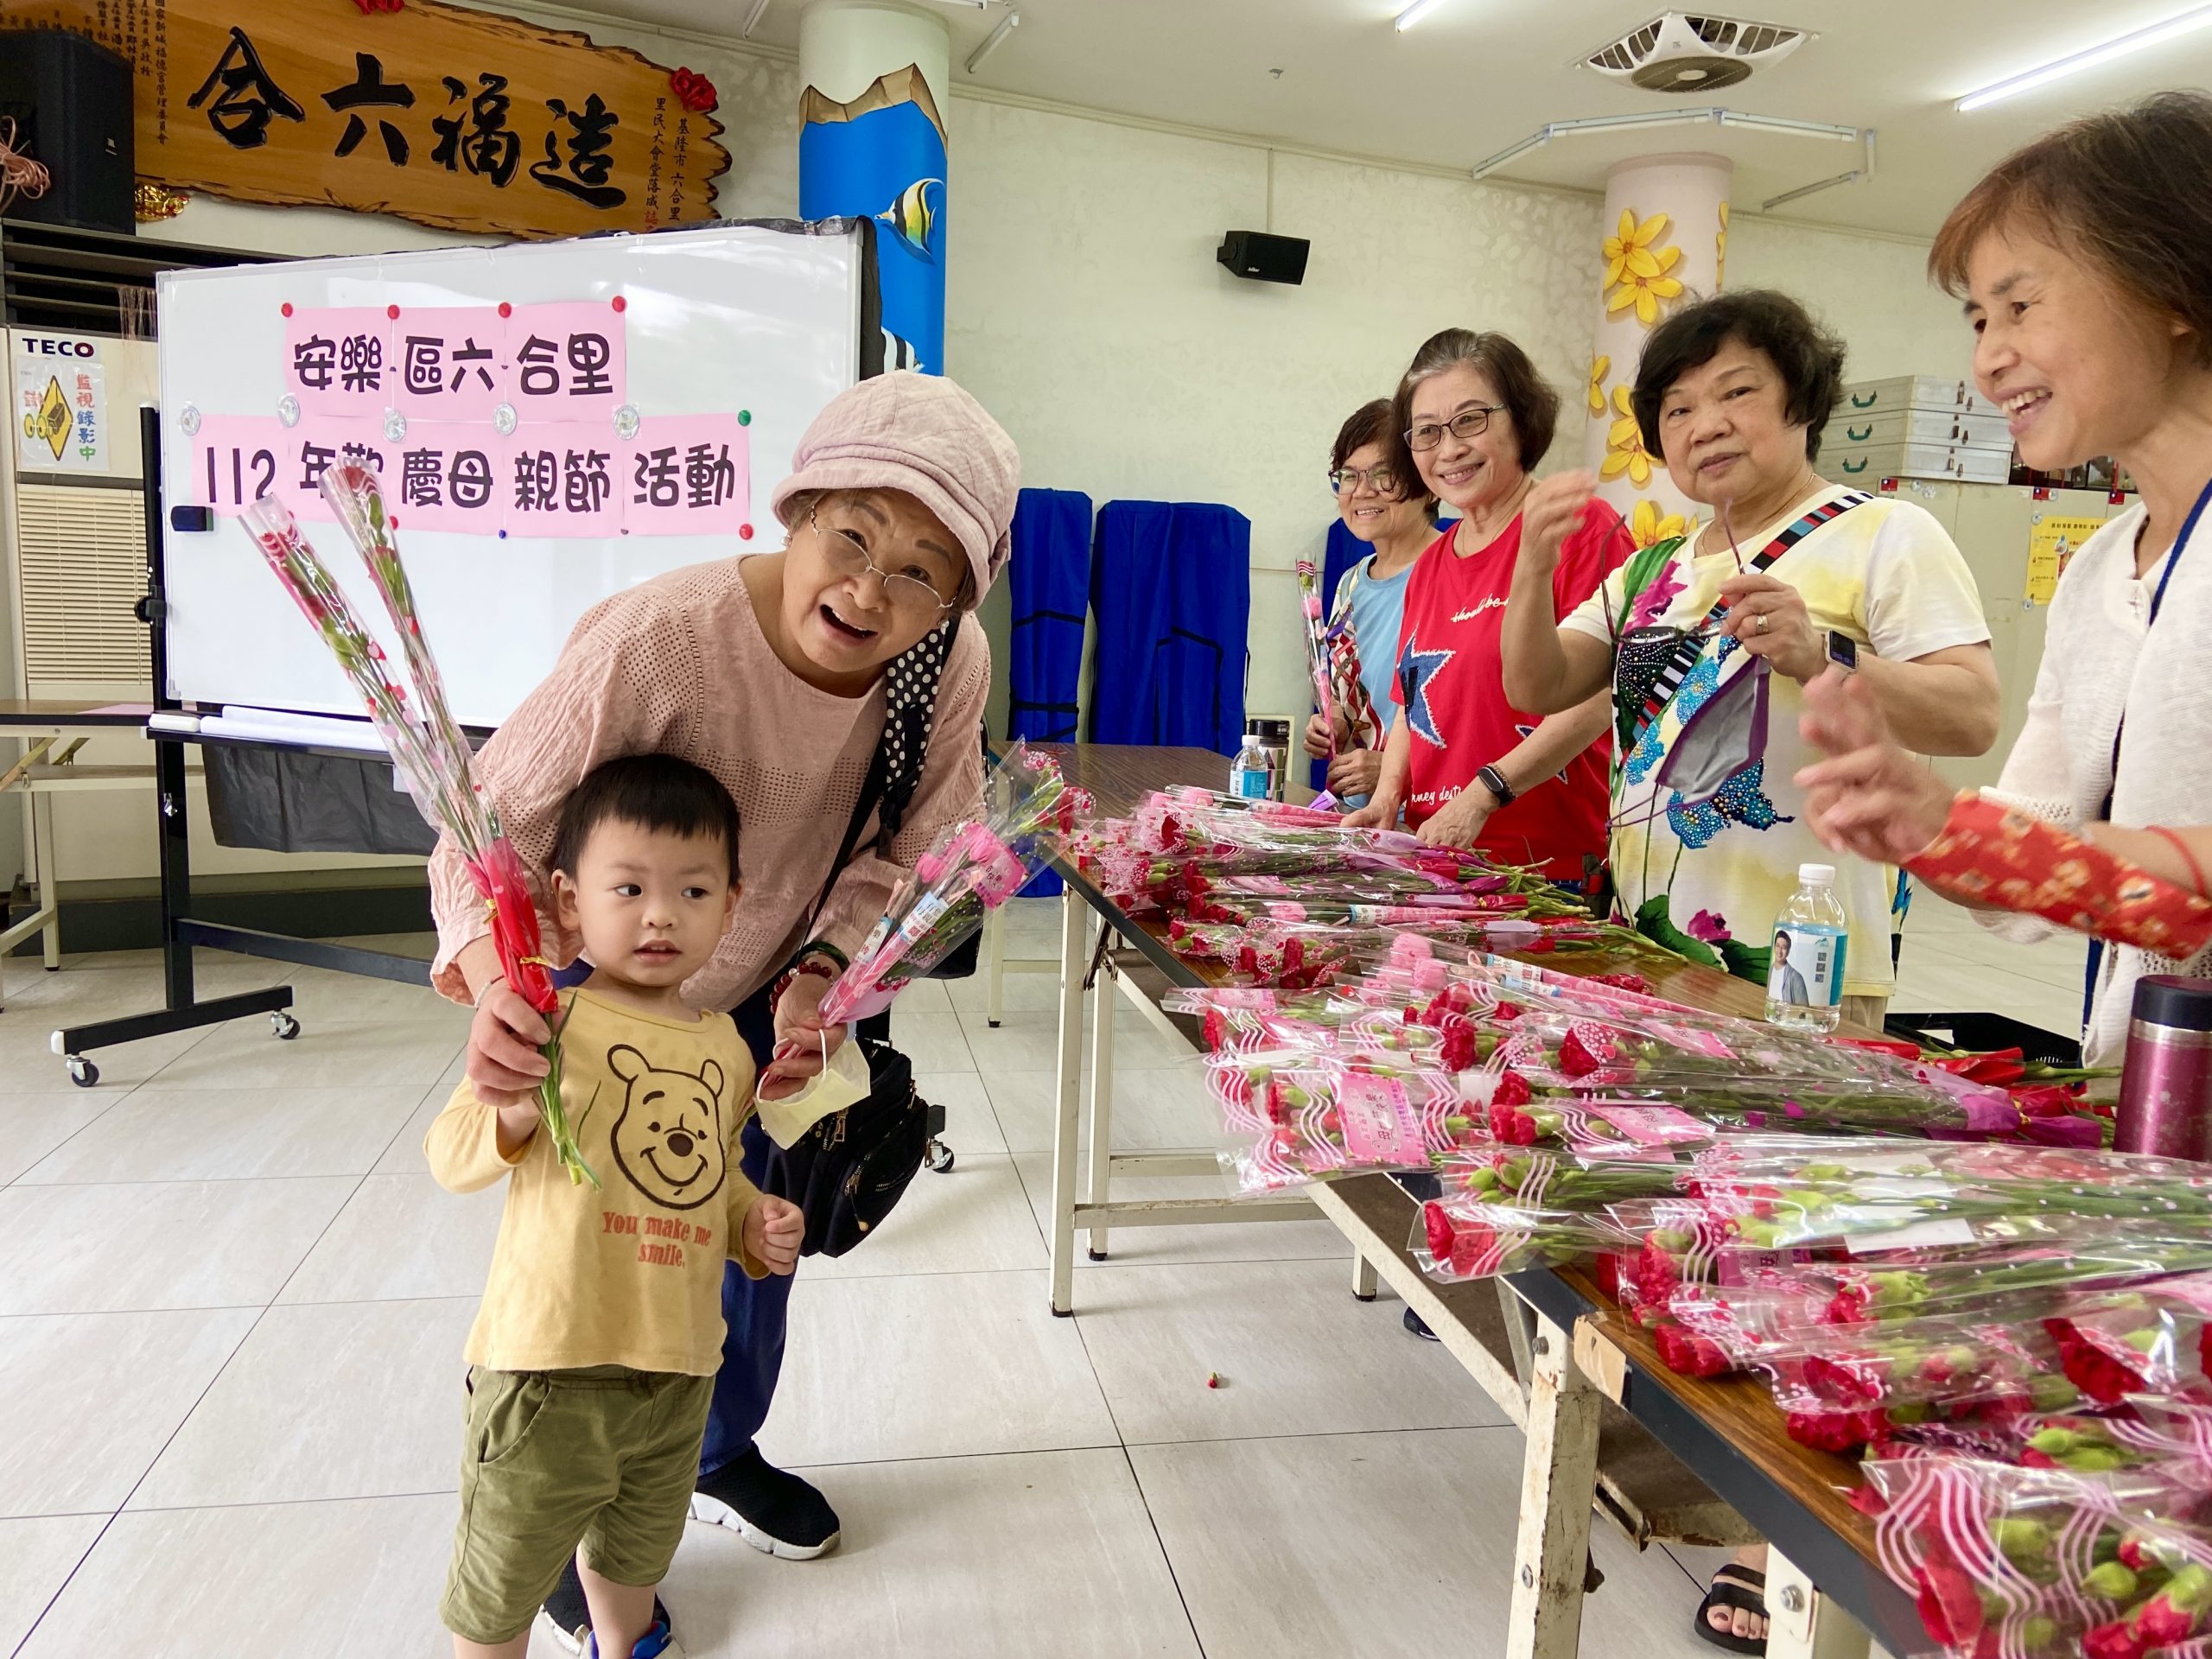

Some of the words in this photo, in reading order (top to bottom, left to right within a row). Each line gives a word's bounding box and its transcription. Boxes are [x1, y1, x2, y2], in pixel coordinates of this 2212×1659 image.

[645, 97, 666, 231] 里民大會堂落成誌
[22, 338, 94, 358] TECO
[294, 333, 613, 395] 安樂區六合里
[76, 374, 96, 461] 監視錄影中
[602, 1211, 638, 1234] You
[645, 1217, 690, 1242] make
[694, 1226, 711, 1246] me
[638, 1243, 685, 1268] smile.
